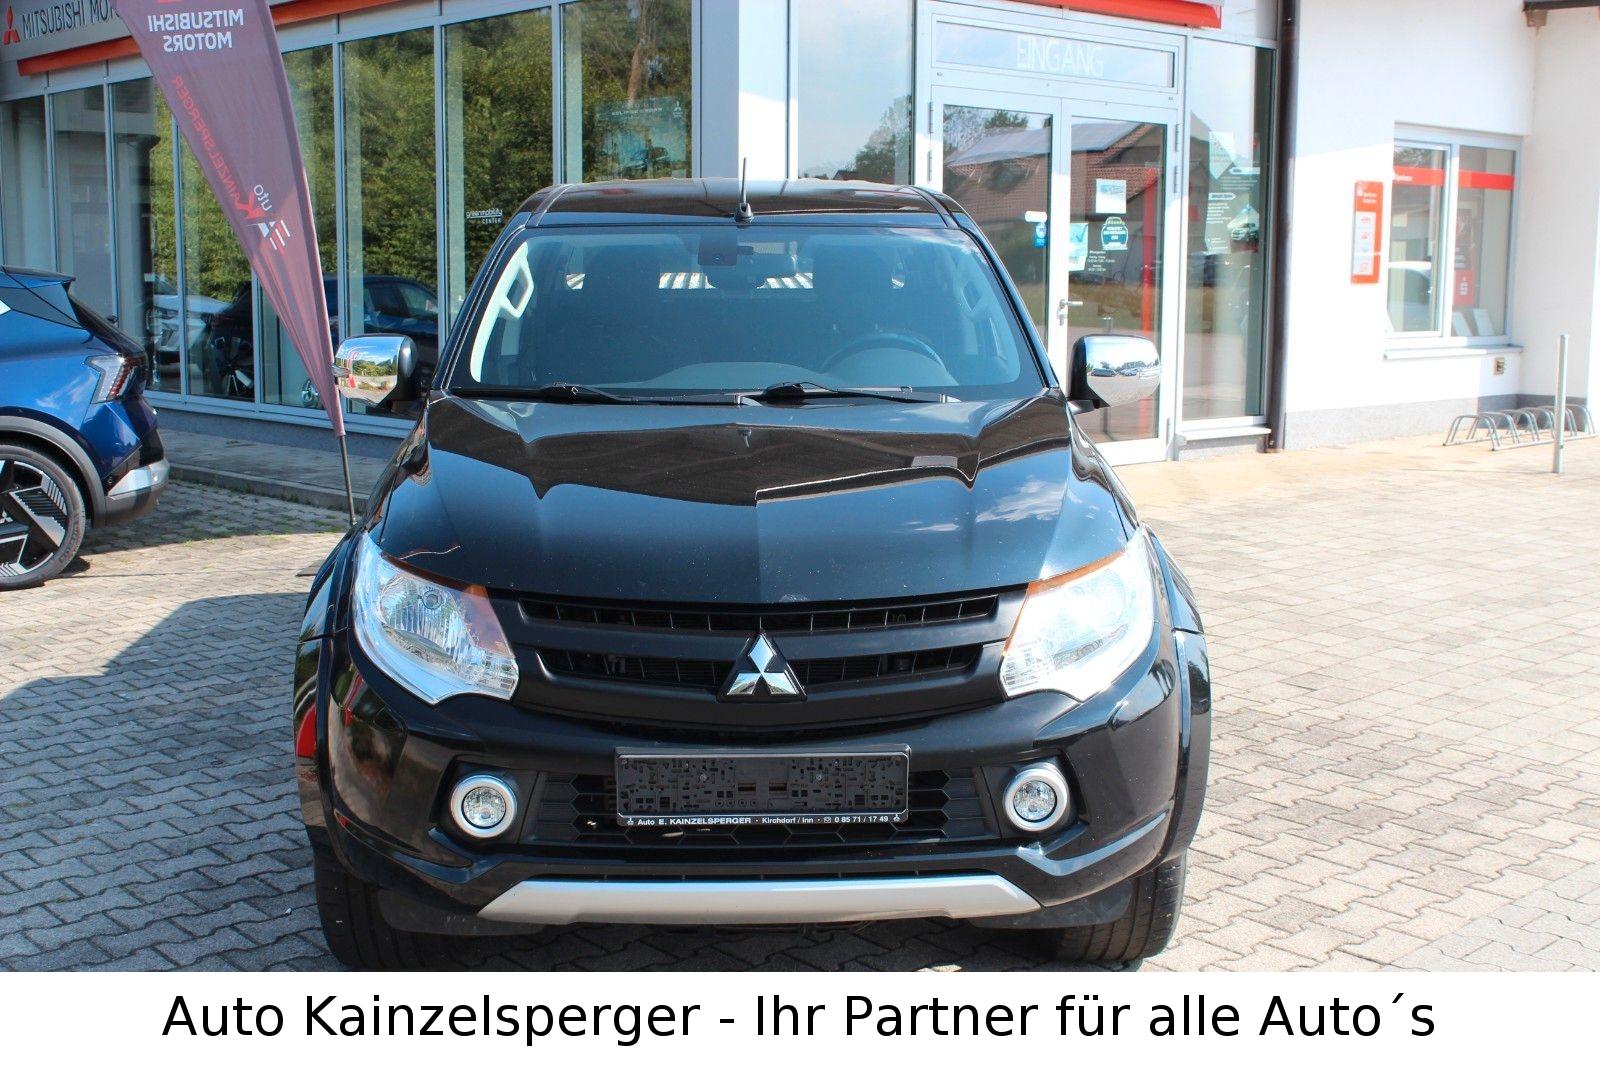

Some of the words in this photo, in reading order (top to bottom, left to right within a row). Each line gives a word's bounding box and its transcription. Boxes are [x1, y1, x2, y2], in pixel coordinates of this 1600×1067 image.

[22, 0, 86, 39] MITSUBISHI
[1016, 35, 1105, 77] EINGANG
[637, 818, 655, 826] Auto
[669, 817, 752, 825] KAINZELSPERGER
